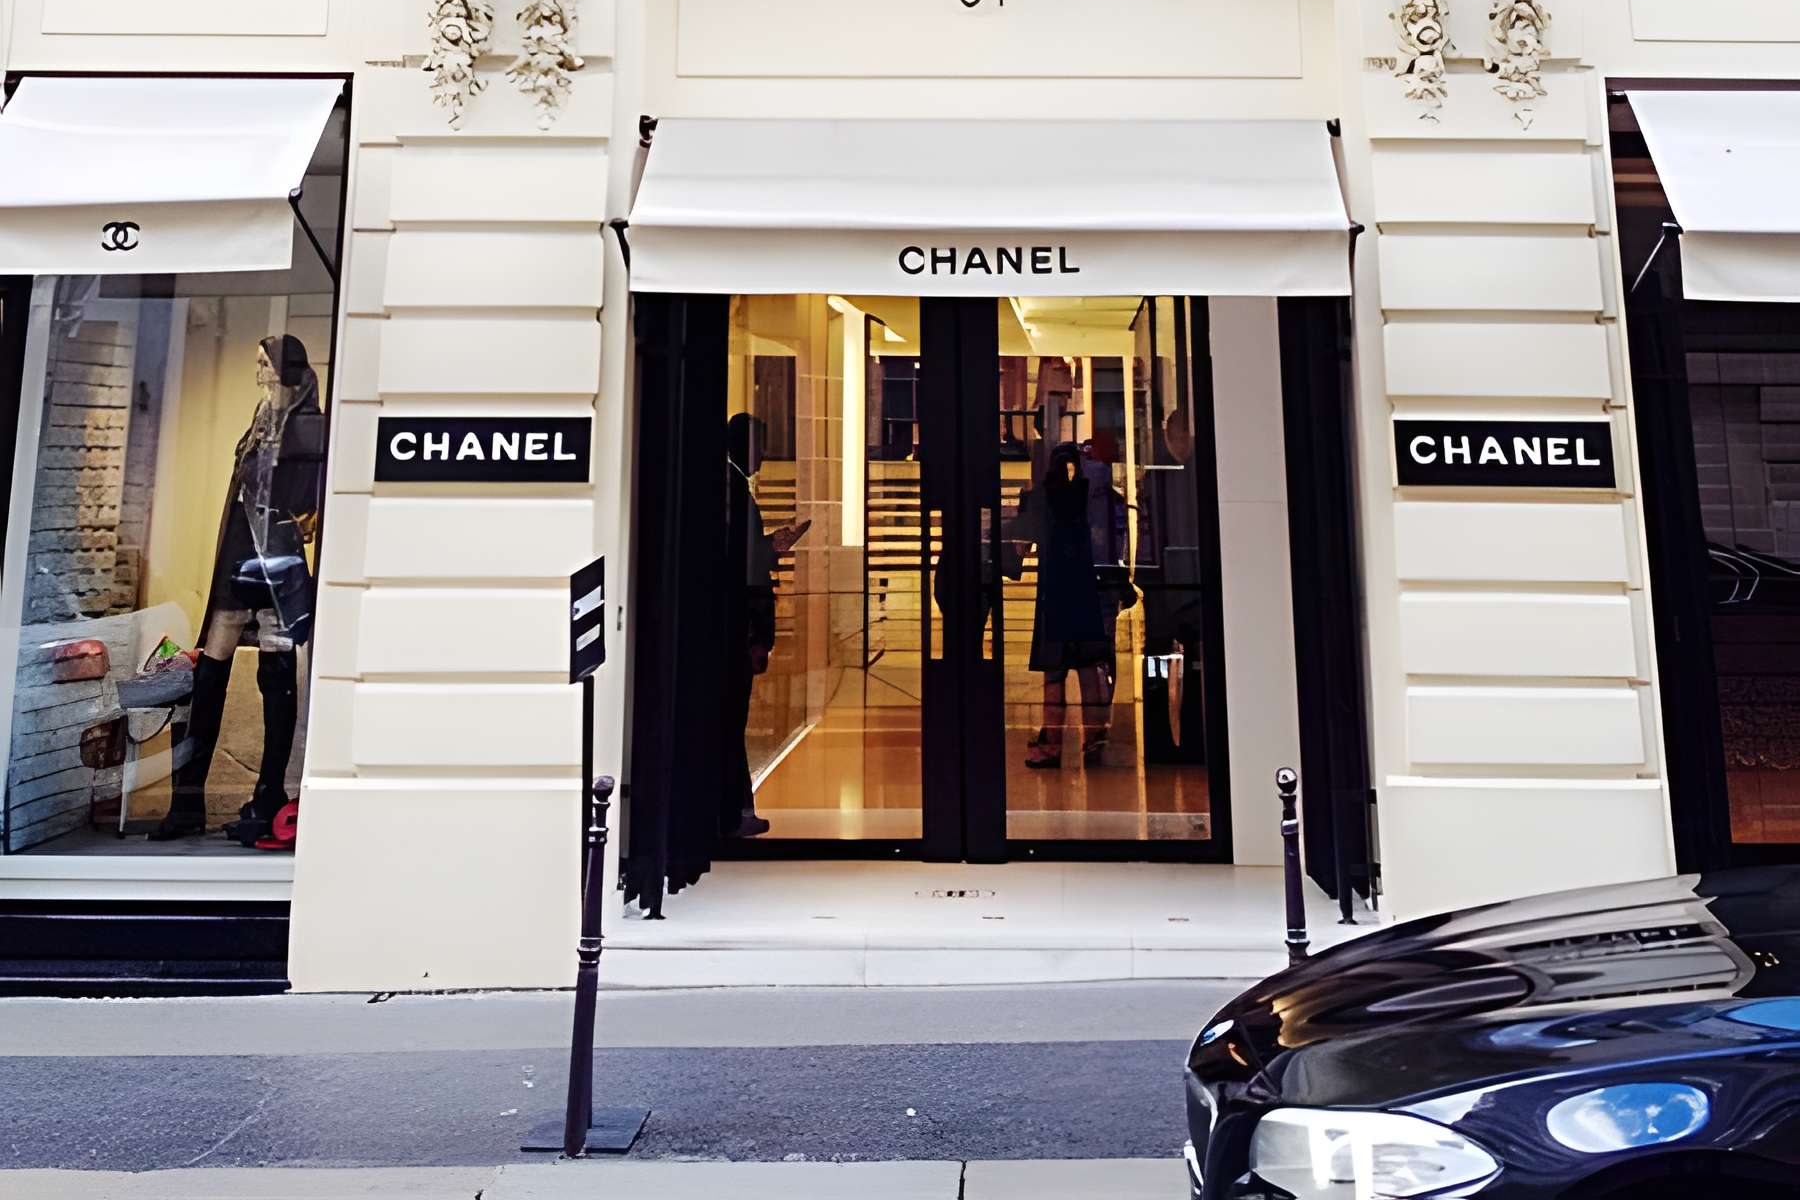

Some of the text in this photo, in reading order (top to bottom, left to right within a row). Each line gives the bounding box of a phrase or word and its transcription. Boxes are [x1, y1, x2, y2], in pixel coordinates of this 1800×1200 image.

[898, 245, 1081, 275] CHANEL
[389, 431, 578, 461] CHANEL
[1409, 435, 1602, 466] CHANEL
